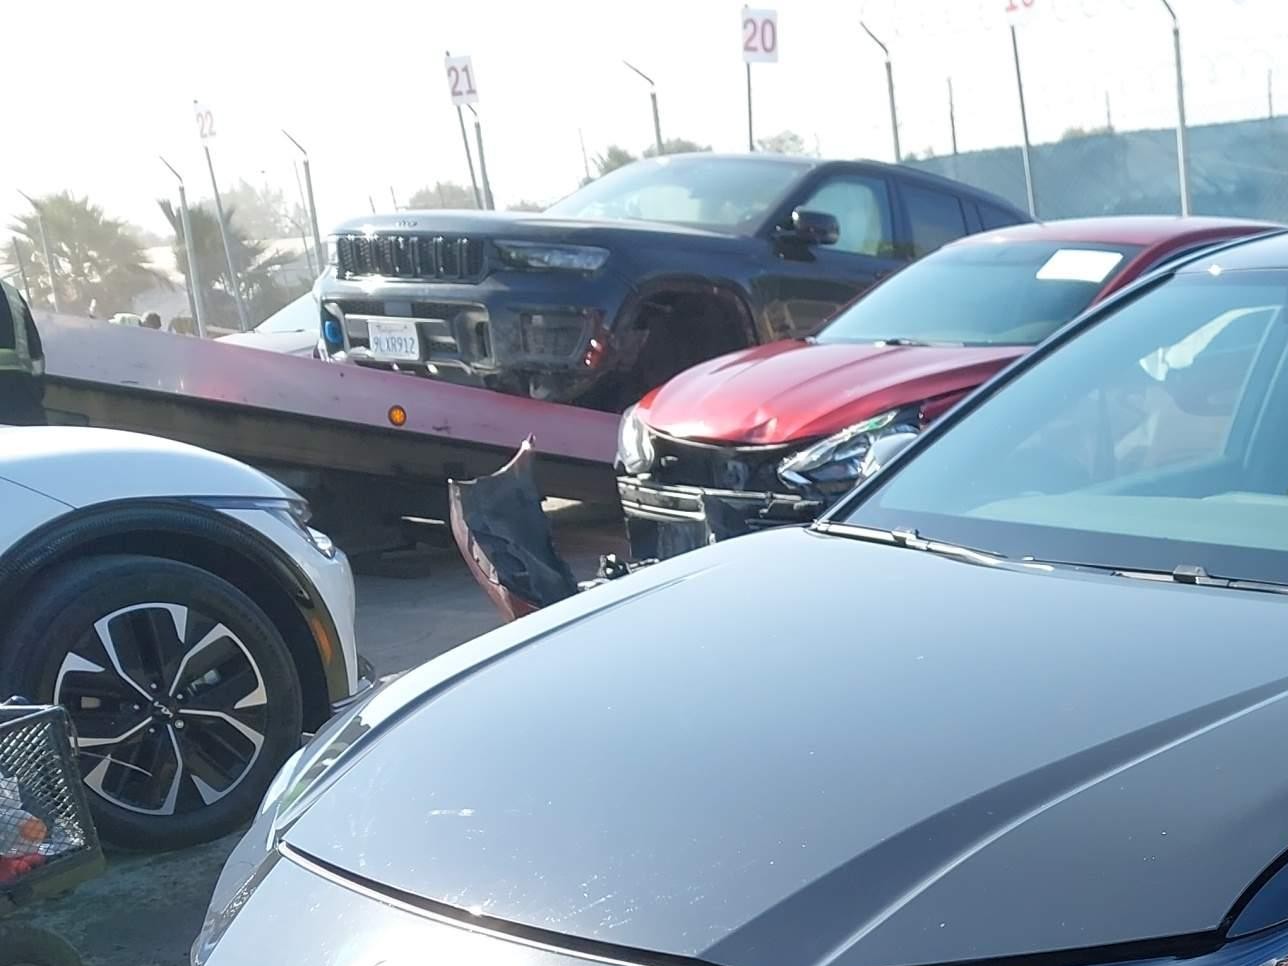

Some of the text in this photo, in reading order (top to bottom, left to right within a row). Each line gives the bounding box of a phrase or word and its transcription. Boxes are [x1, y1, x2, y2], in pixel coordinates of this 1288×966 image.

[741, 18, 777, 54] 20
[447, 64, 477, 97] 21
[195, 110, 217, 139] 22
[373, 335, 416, 354] 9LXR912
